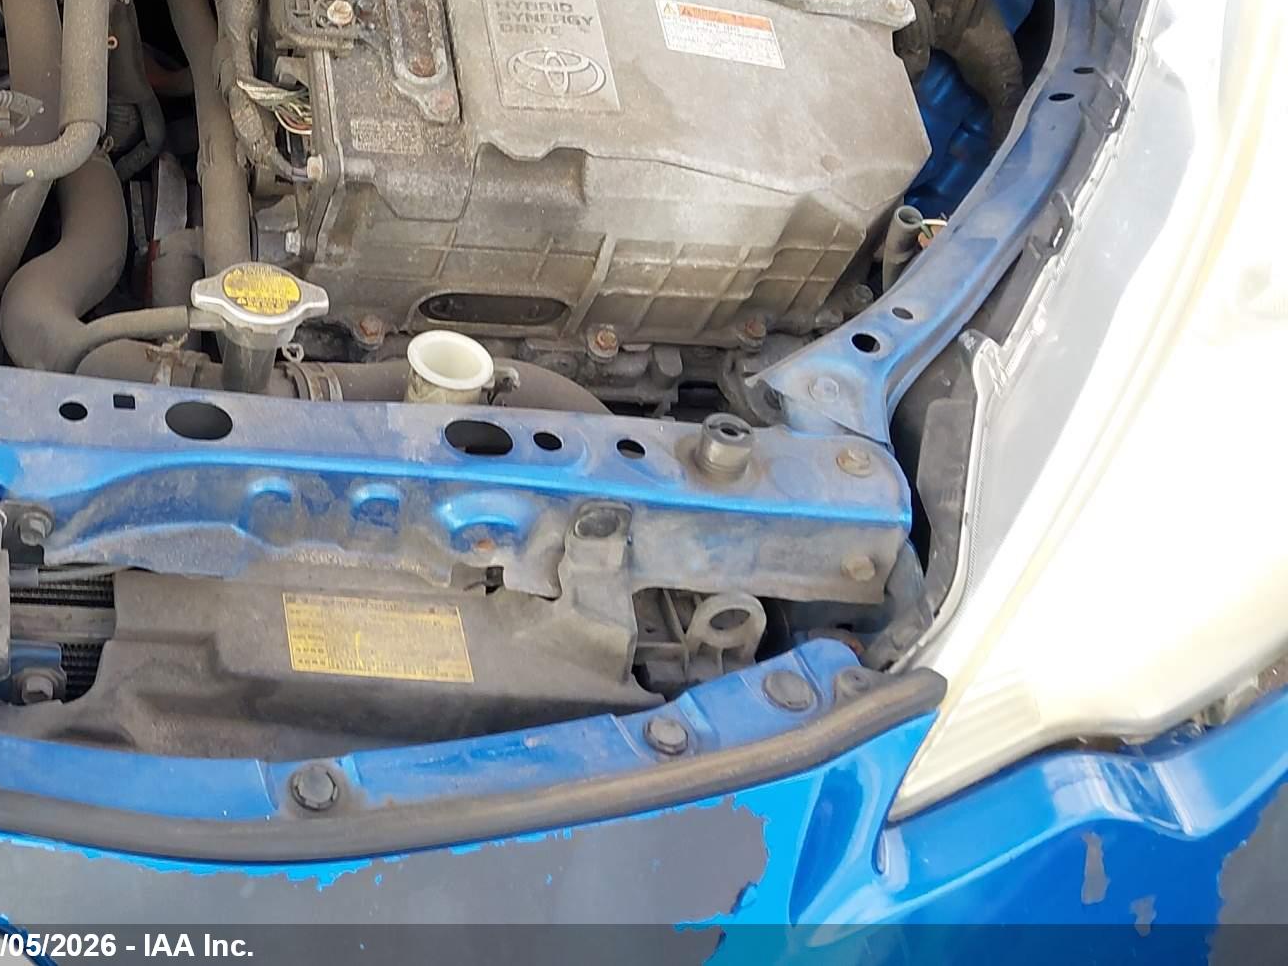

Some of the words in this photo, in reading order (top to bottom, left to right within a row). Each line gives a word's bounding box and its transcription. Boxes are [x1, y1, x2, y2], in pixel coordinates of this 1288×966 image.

[495, 0, 573, 13] HYBRID
[497, 12, 593, 26] SYNERGY
[500, 23, 561, 35] DRIVE
